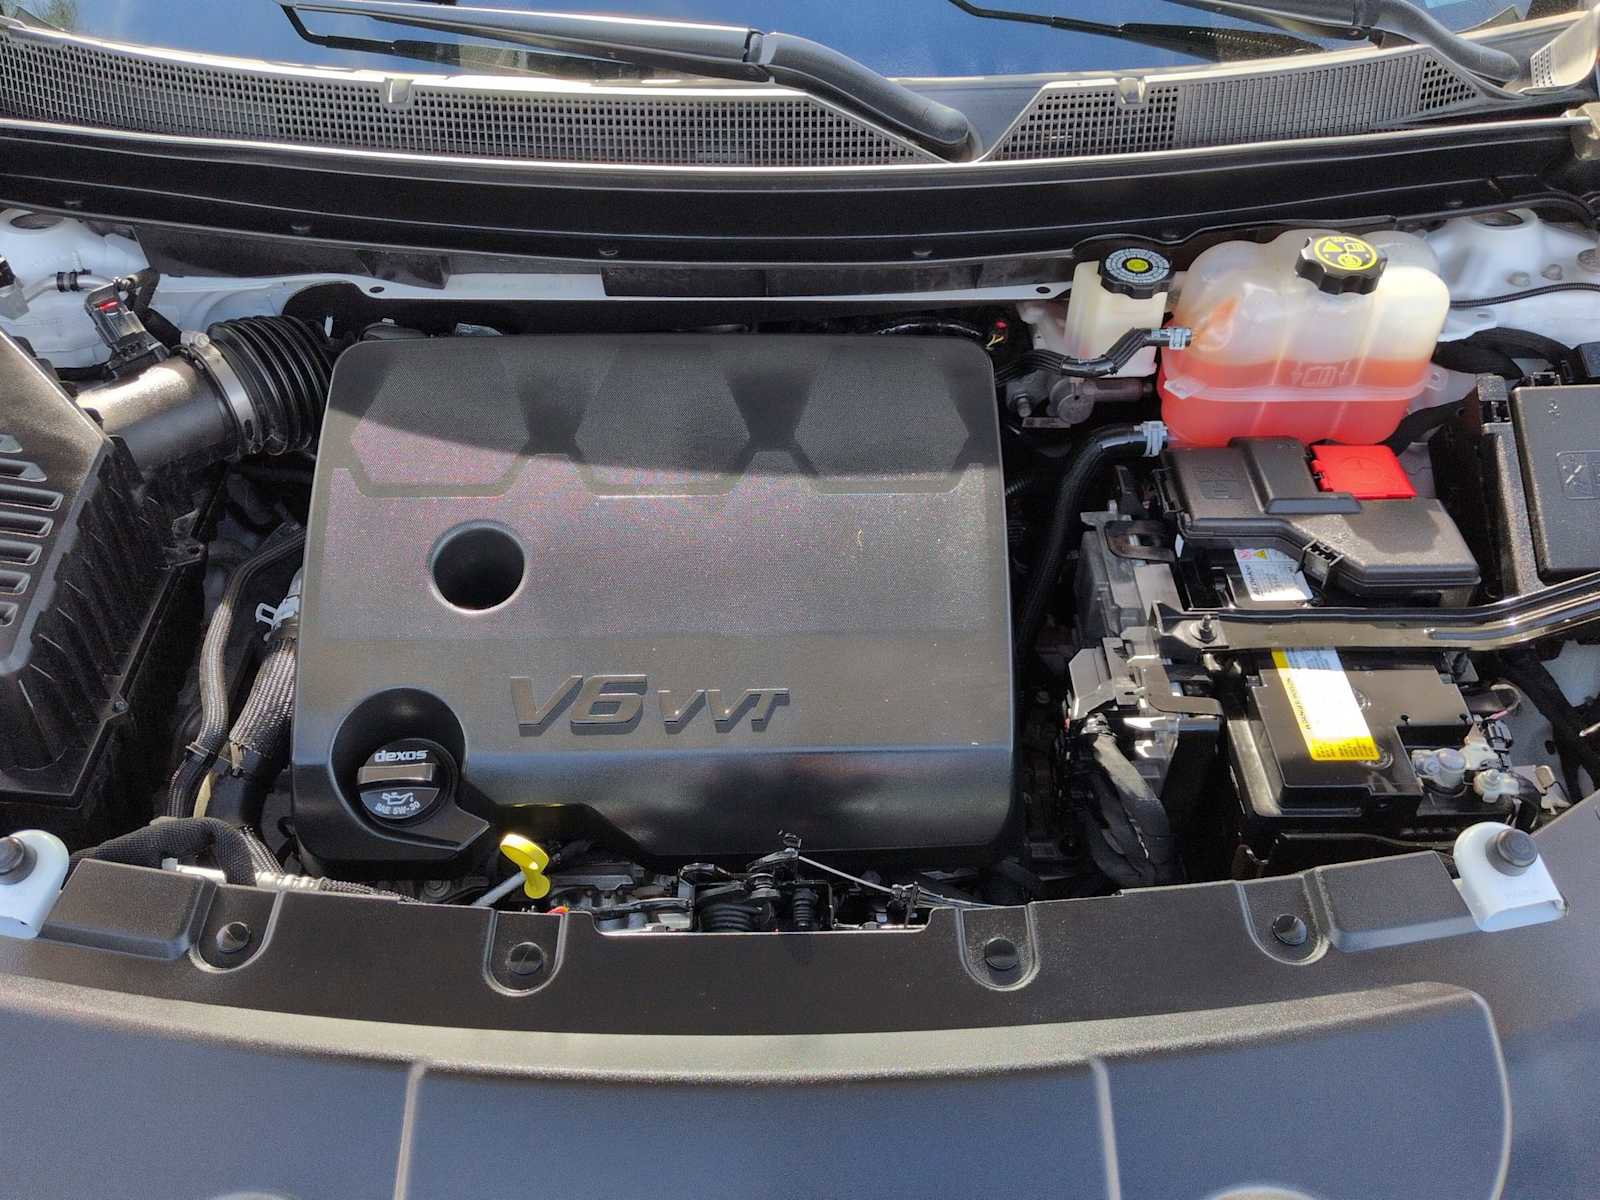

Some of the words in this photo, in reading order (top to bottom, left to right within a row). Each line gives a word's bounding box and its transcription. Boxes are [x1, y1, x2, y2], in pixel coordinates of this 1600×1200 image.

[510, 673, 647, 736] V6
[657, 687, 790, 734] VVT
[374, 750, 428, 762] dexos
